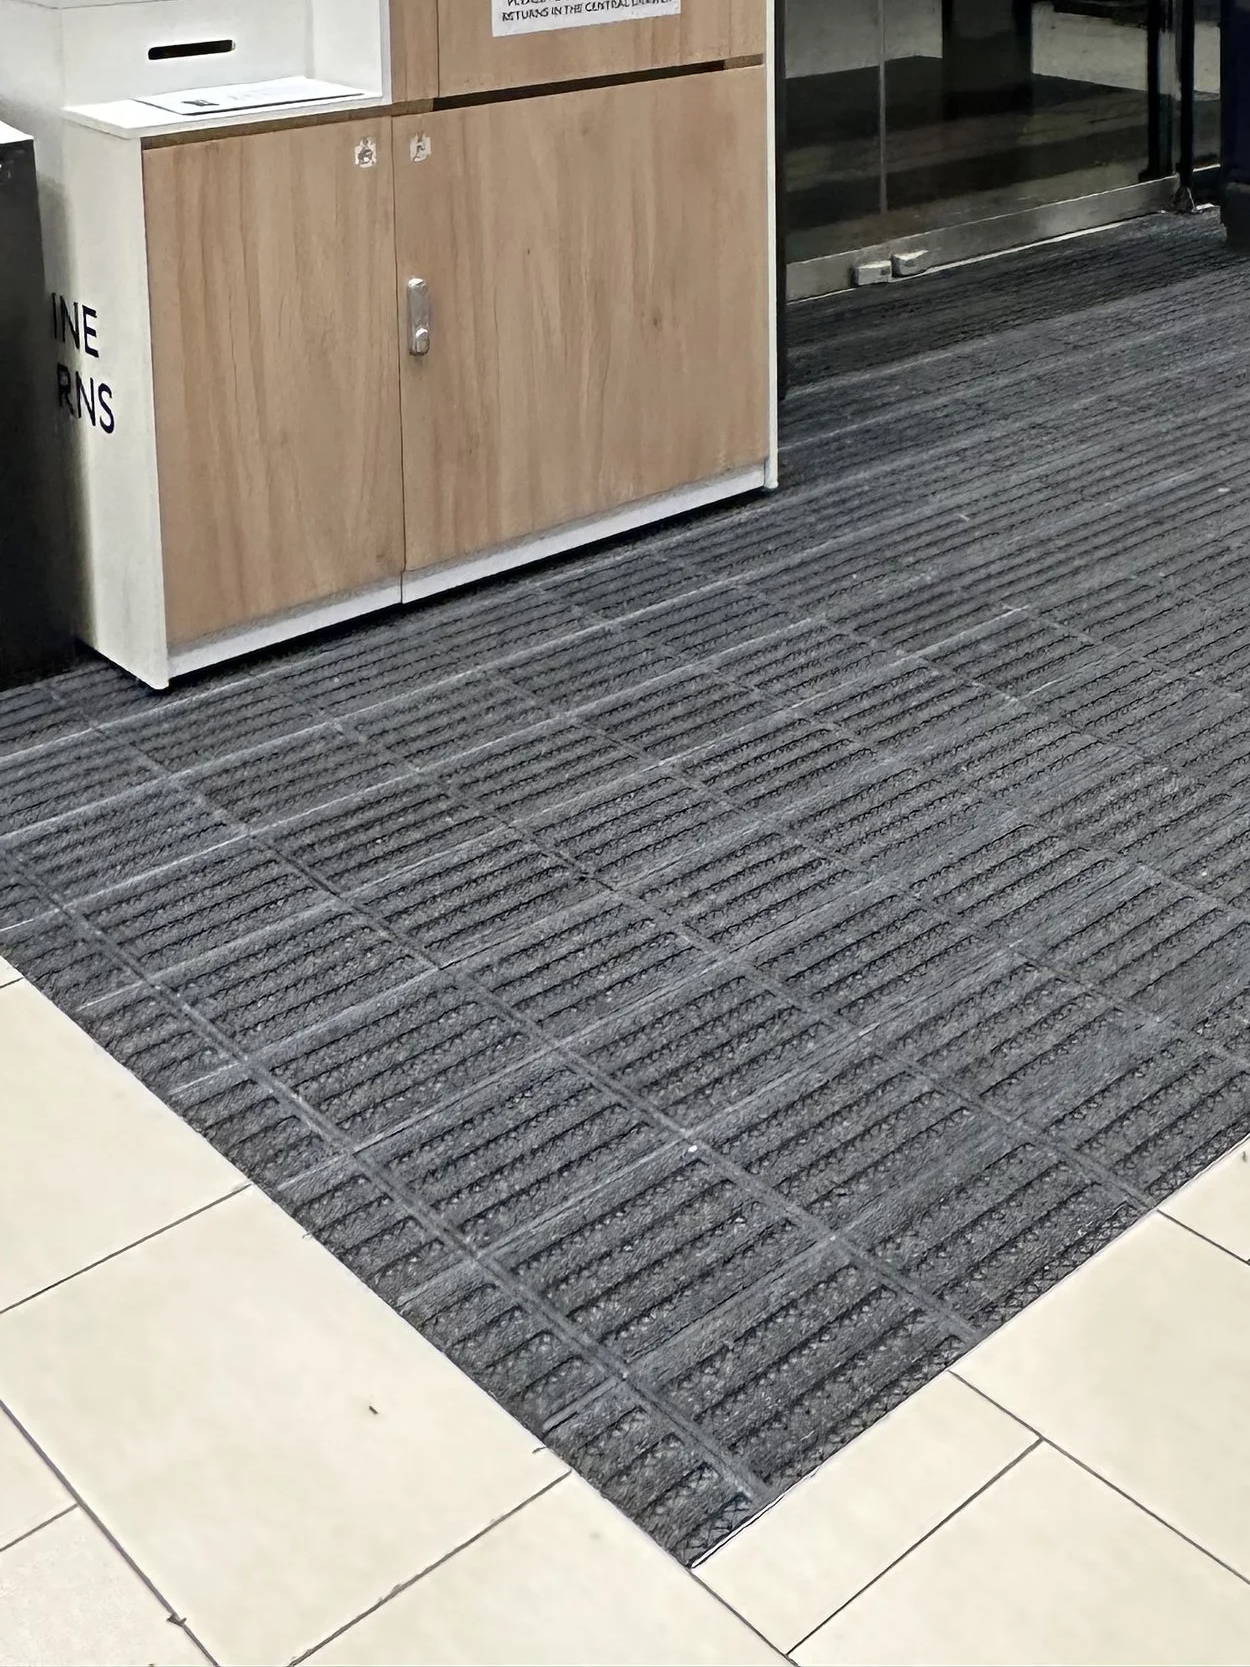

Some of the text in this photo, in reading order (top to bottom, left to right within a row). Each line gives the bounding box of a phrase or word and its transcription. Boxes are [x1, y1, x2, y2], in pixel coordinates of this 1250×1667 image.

[502, 7, 549, 22] RETURNS
[551, 5, 563, 16] IN
[564, 2, 584, 15] THE
